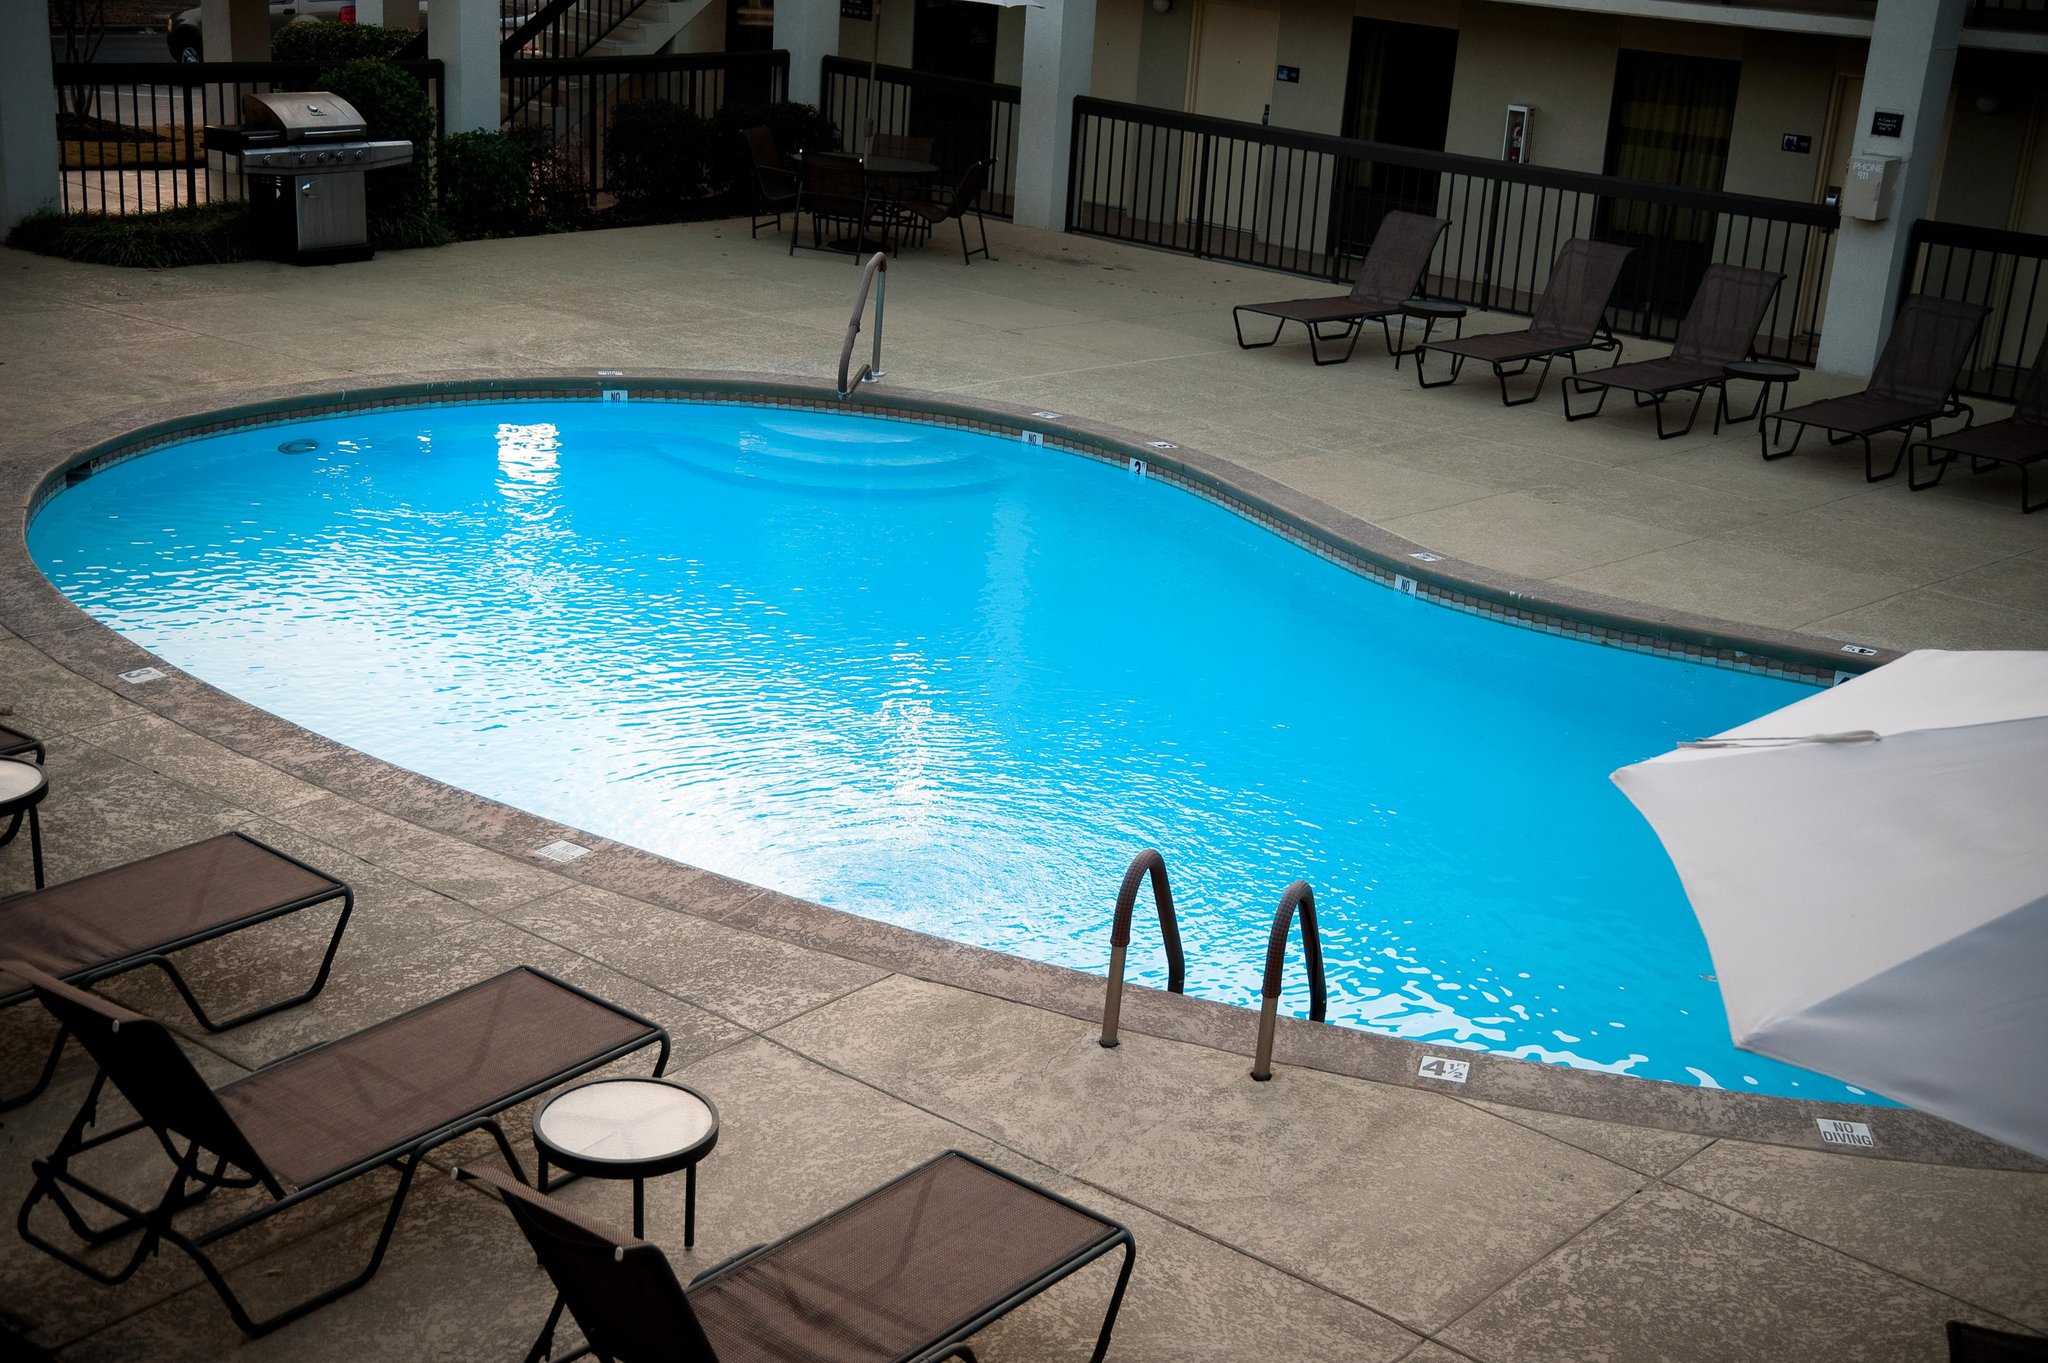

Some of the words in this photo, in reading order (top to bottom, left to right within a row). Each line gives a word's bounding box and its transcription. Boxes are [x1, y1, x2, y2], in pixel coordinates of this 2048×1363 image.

[1853, 162, 1883, 173] PHONE
[1858, 171, 1869, 179] 911
[611, 392, 620, 402] NO
[1028, 433, 1037, 443] NO
[1401, 578, 1410, 592] NO
[1832, 1121, 1854, 1133] NO
[1822, 1131, 1873, 1146] DIVING
